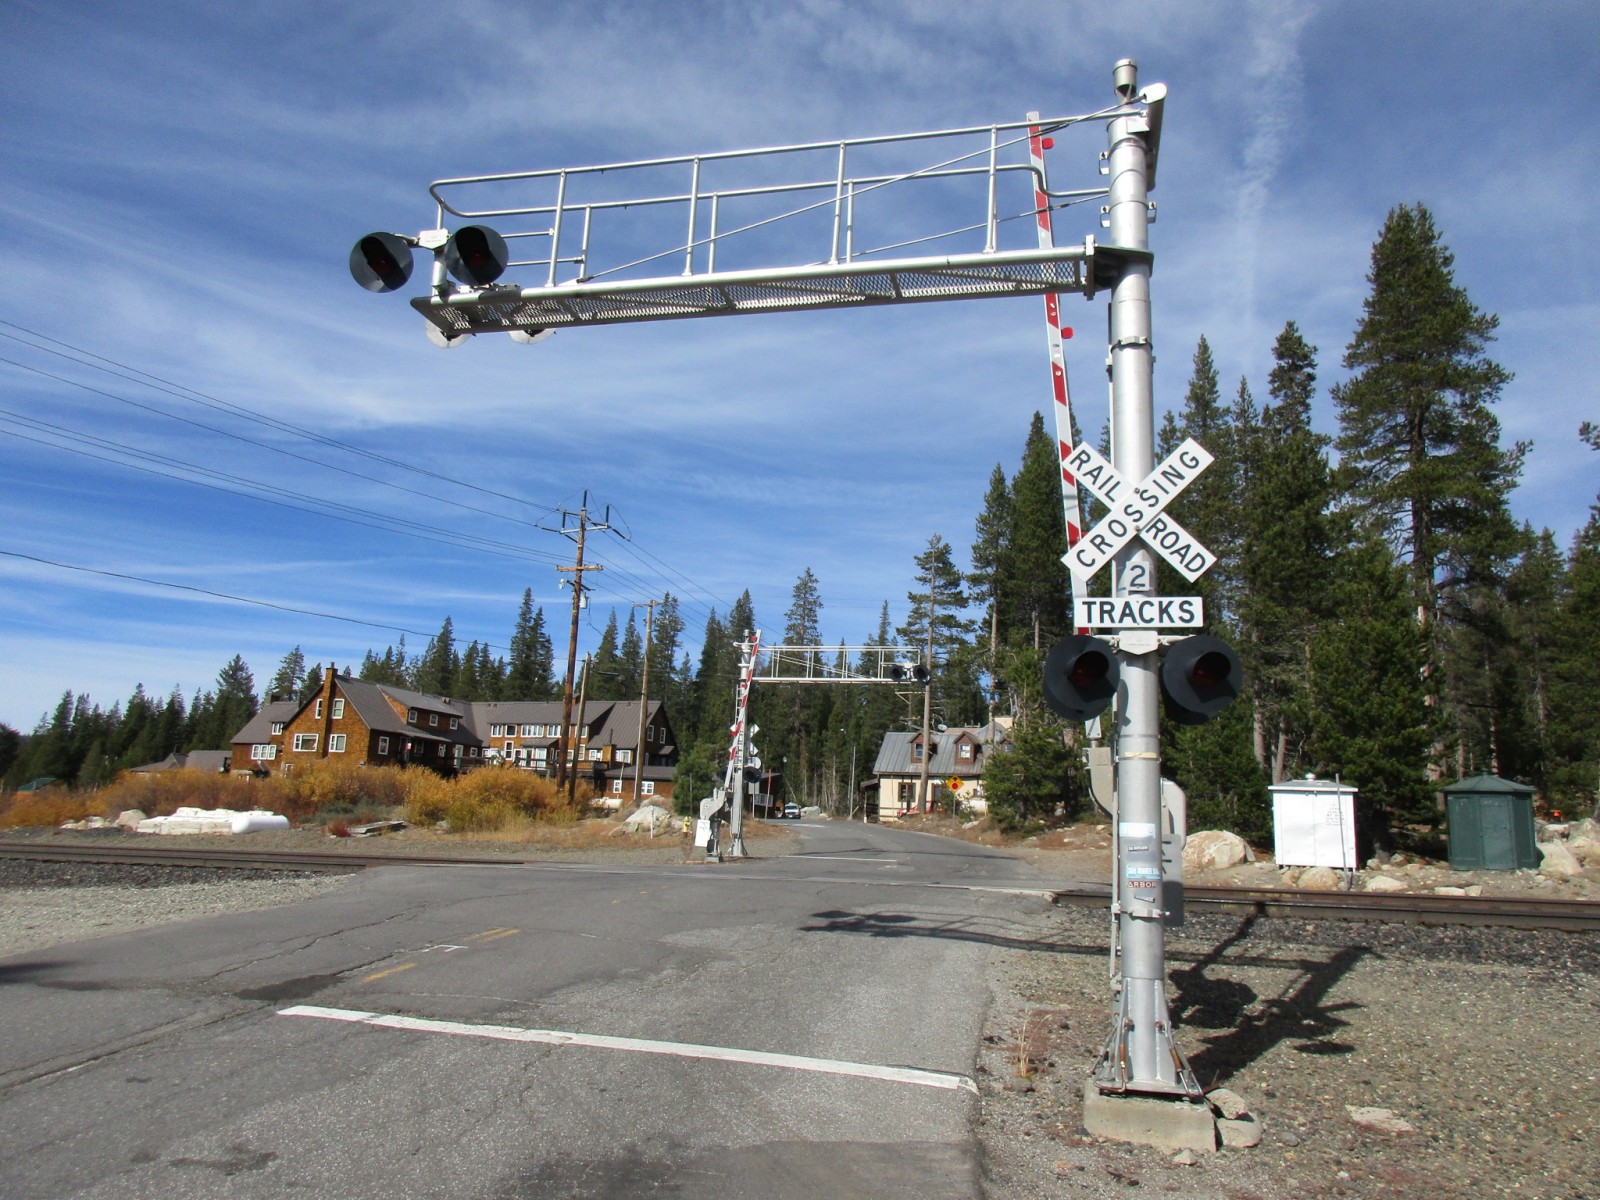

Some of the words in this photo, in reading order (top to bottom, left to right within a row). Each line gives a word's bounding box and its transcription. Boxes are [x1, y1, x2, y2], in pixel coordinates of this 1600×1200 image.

[1070, 450, 1121, 502] RAIL
[1146, 517, 1206, 573] ROAD
[1076, 451, 1200, 568] CROSSING
[1130, 564, 1146, 587] 2
[1082, 600, 1195, 624] TRACKS
